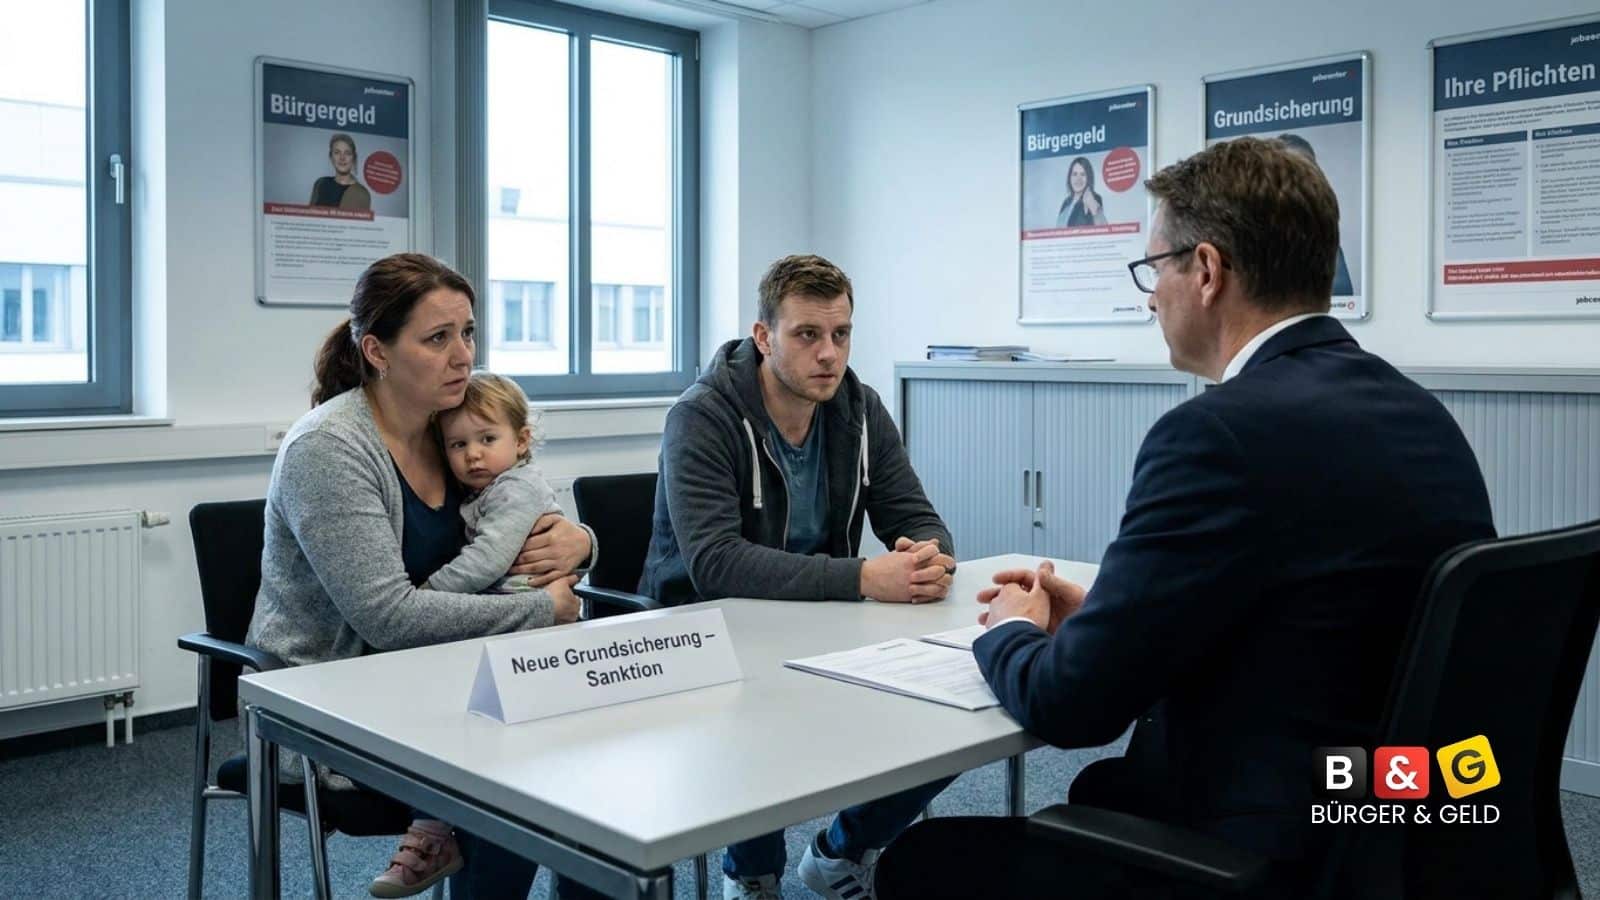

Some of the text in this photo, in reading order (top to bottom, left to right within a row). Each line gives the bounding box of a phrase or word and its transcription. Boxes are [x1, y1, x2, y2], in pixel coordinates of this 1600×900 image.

[1444, 63, 1596, 99] Ihre Pflichten
[270, 93, 376, 127] Bürgergeld
[1213, 96, 1354, 129] Grundsicherung
[1027, 124, 1106, 153] Bürgergeld
[511, 656, 560, 674] Neue
[564, 632, 702, 665] Grundsicherung
[586, 661, 664, 687] Sanktion
